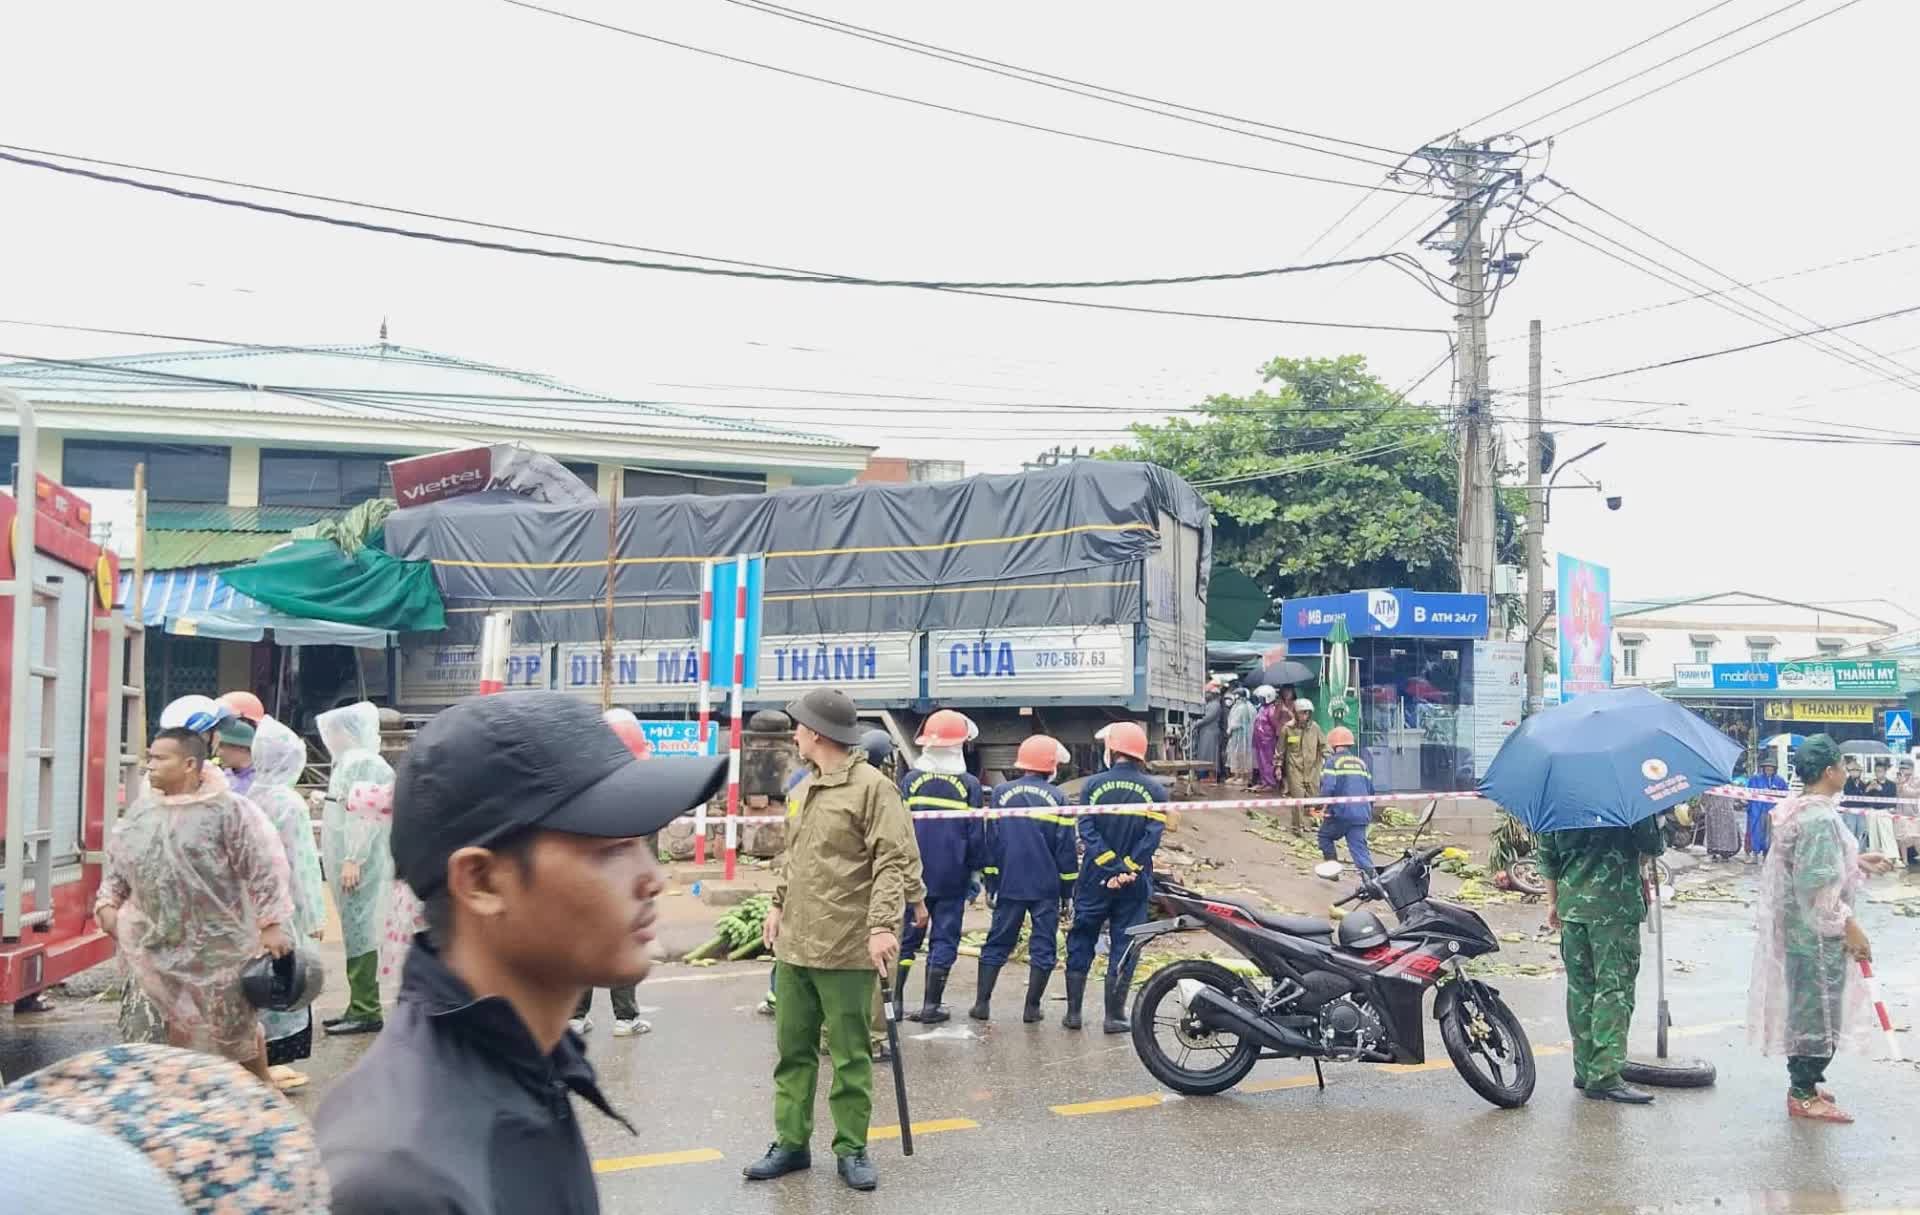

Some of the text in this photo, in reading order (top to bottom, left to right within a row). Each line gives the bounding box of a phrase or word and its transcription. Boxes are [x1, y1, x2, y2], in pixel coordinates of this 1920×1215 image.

[1375, 600, 1396, 615] ATM
[1309, 609, 1321, 625] MB
[1431, 613, 1453, 623] ATM
[1454, 613, 1478, 623] 24/7
[1035, 651, 1106, 668] 37C-587.63
[571, 653, 637, 686] ĐIN
[1720, 671, 1769, 682] mobifone
